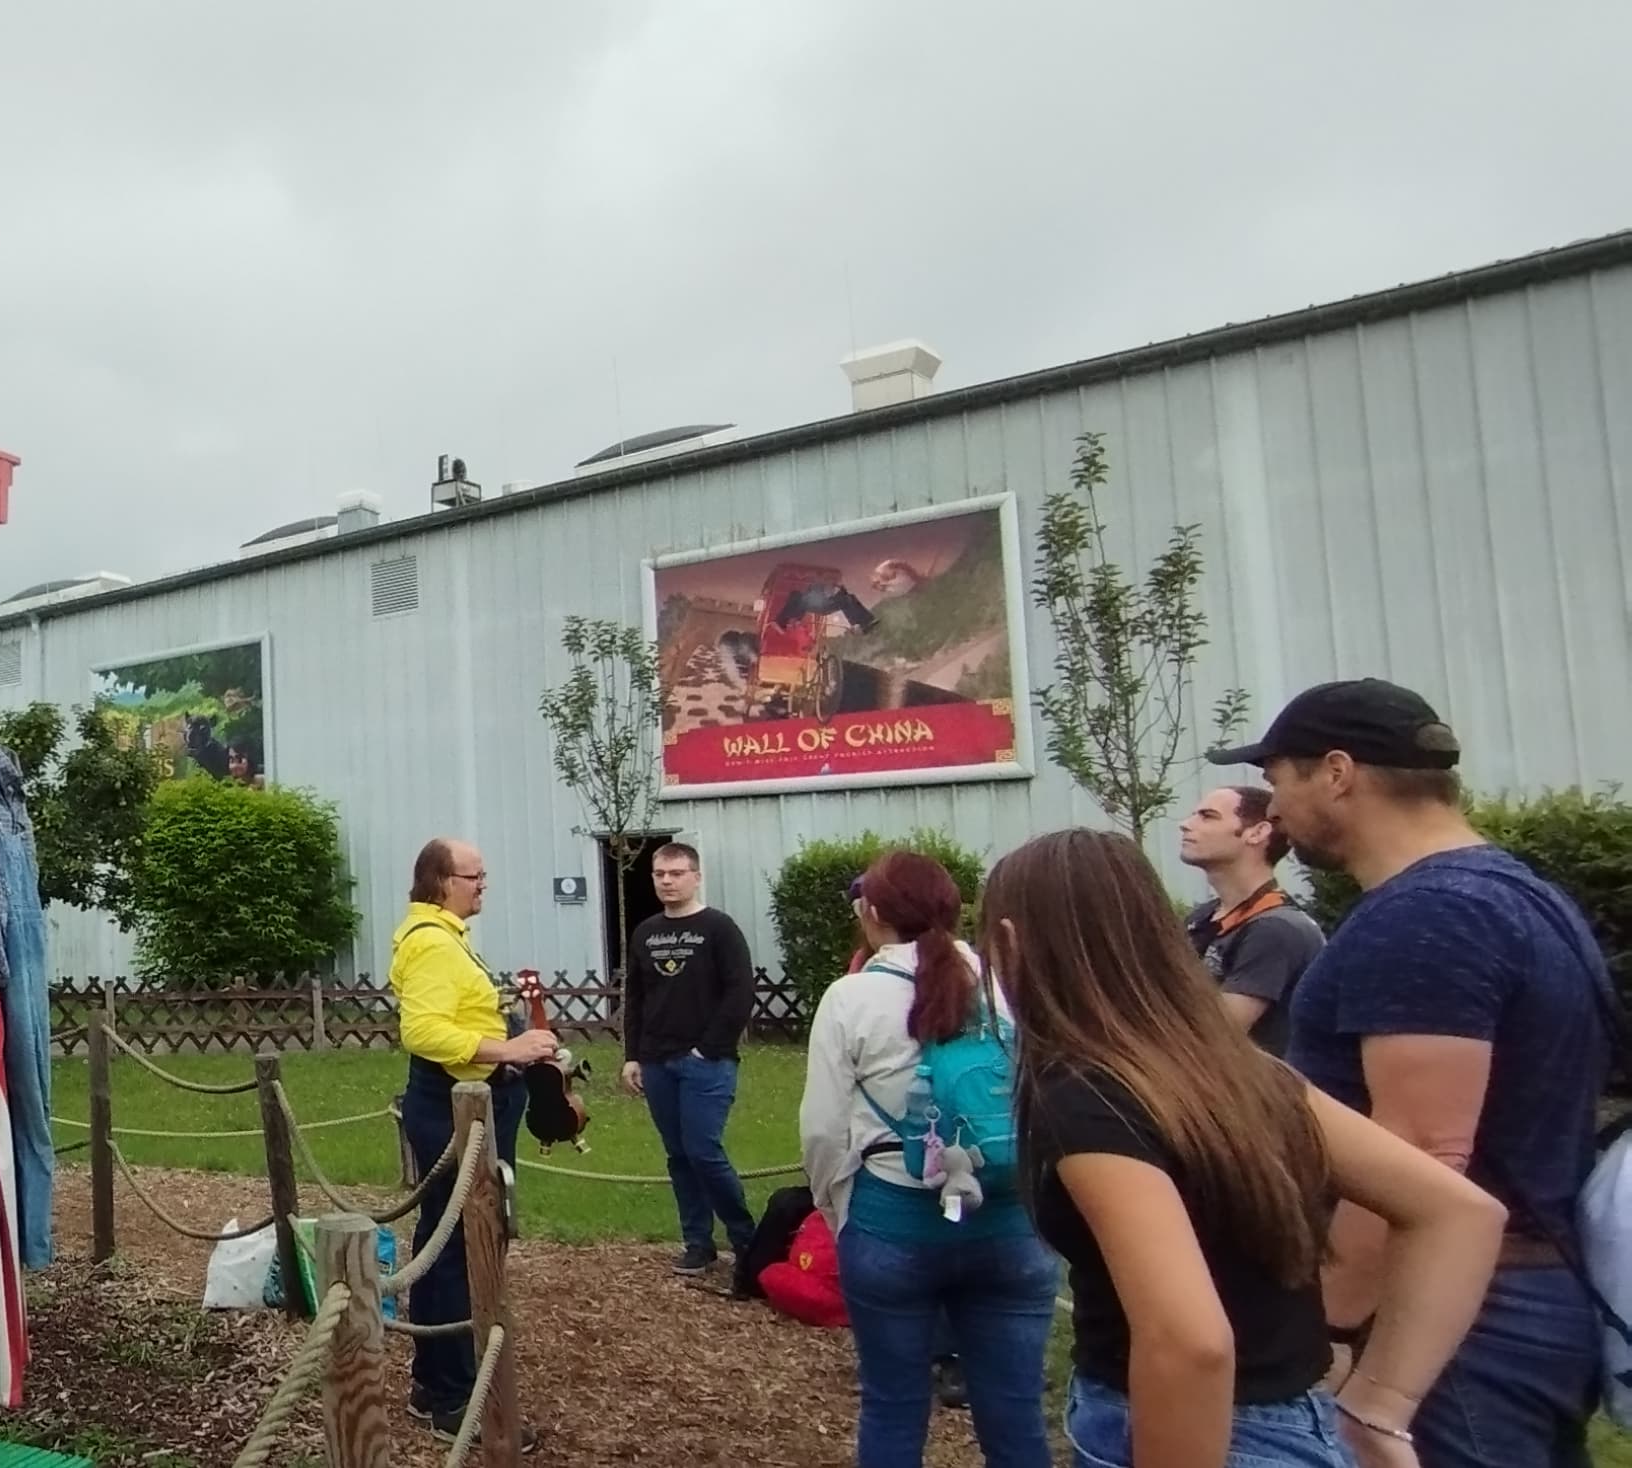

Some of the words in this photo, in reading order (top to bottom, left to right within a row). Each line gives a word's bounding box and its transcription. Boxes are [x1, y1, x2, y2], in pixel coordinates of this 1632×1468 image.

[723, 731, 792, 757] WALL
[797, 725, 838, 751] OF
[844, 718, 935, 748] CHINA
